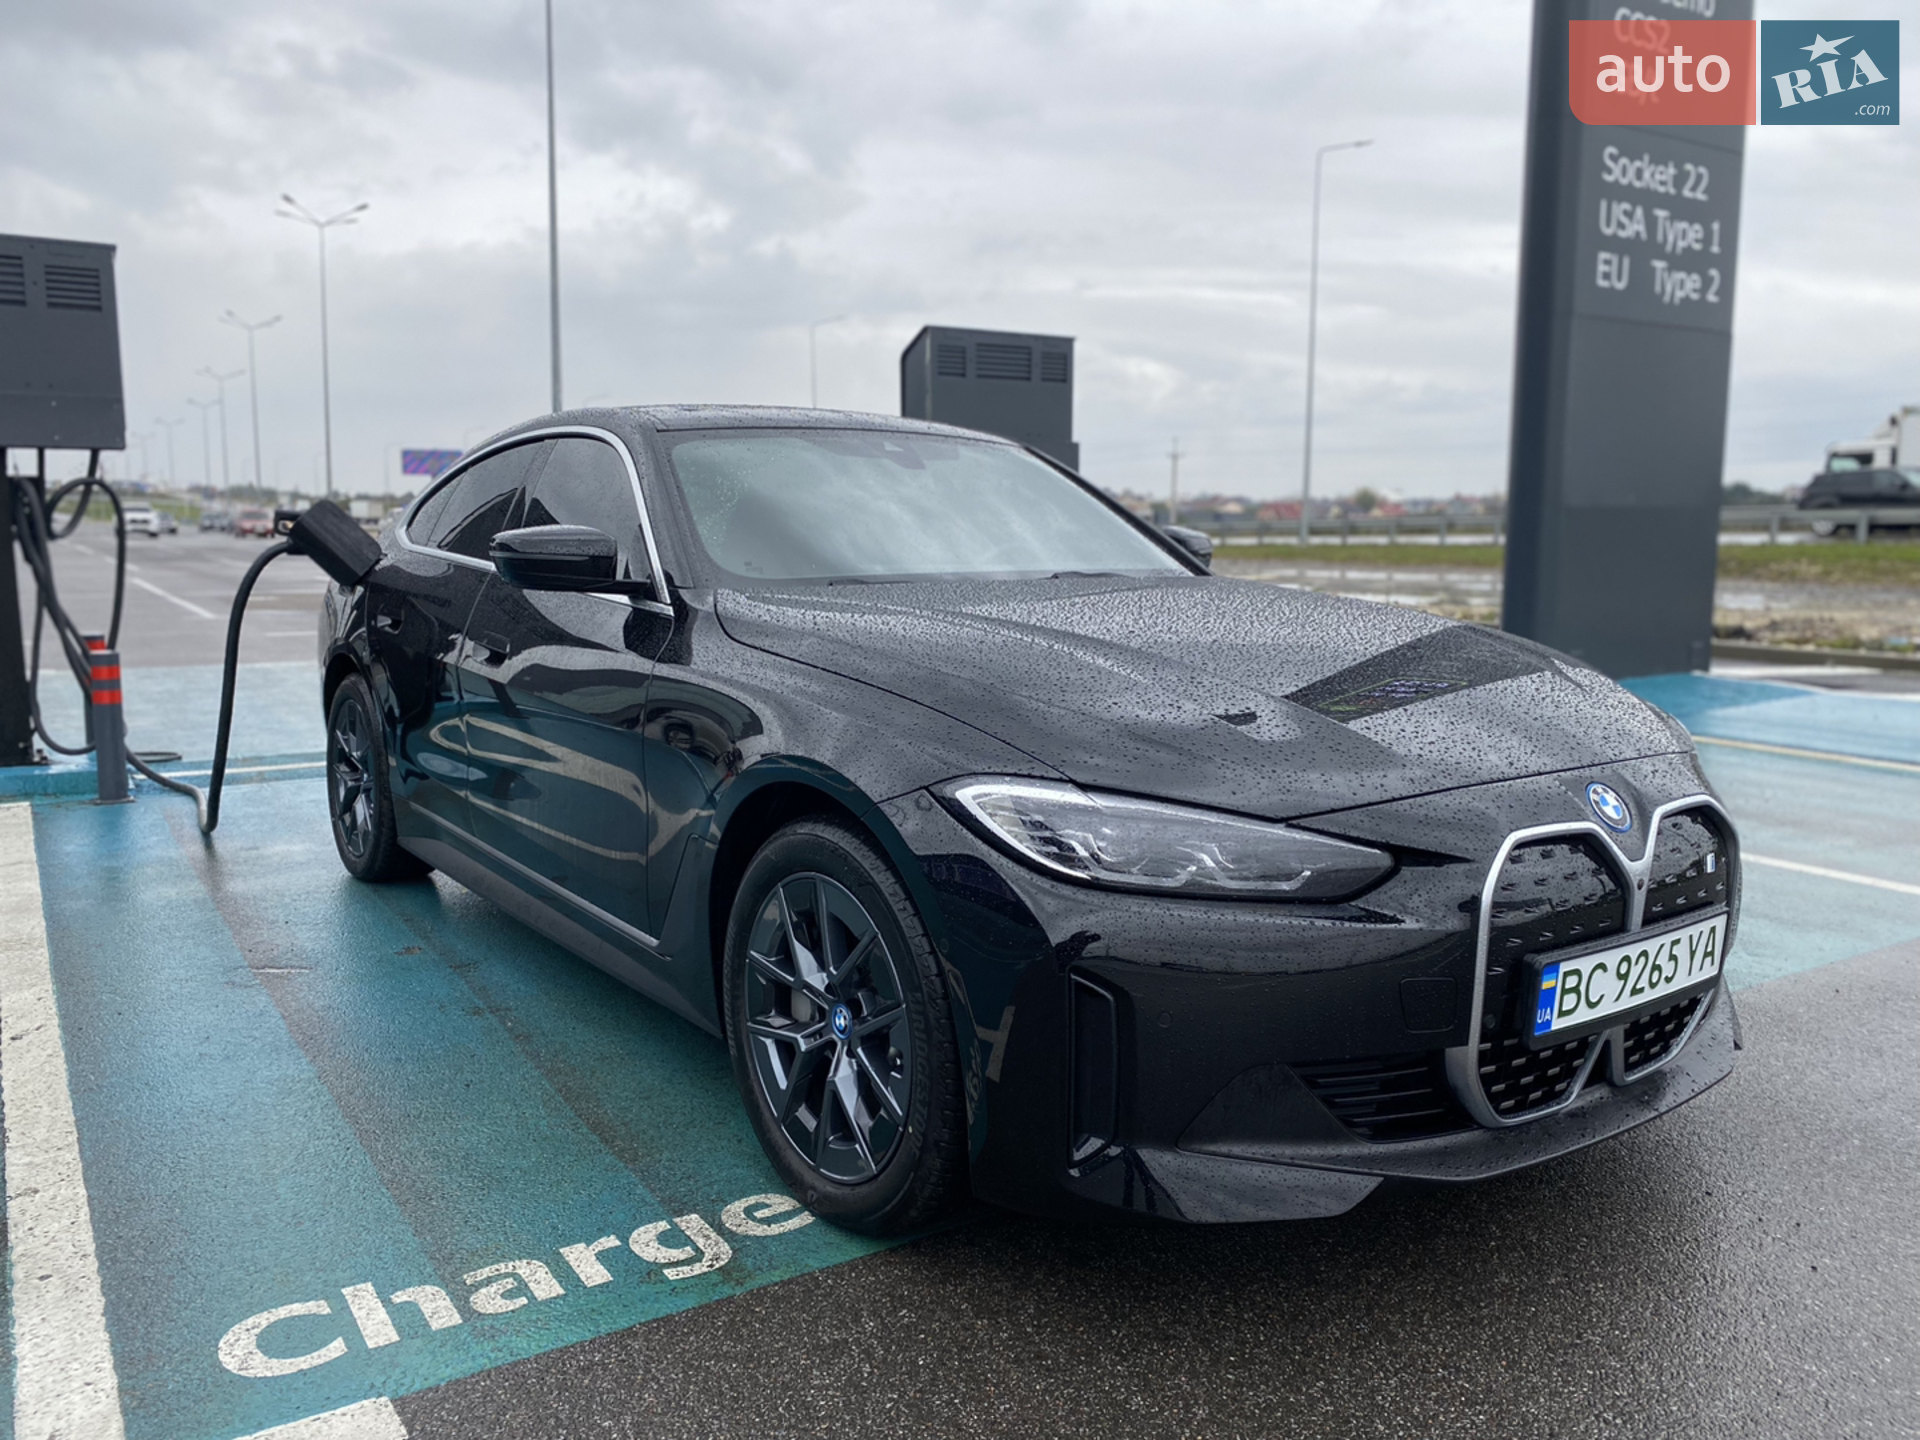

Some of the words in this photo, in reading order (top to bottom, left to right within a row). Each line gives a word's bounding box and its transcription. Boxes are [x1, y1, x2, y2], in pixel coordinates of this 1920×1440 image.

[1601, 145, 1677, 195] Socket
[1682, 162, 1710, 201] 22
[1599, 198, 1648, 241] USA
[1652, 207, 1704, 256] Type
[1710, 220, 1721, 254] 1
[1596, 250, 1630, 291] EU
[1650, 259, 1702, 306] Type
[1705, 267, 1721, 303] 2
[1557, 962, 1609, 1019] BC
[1613, 938, 1682, 1003] 9265
[1687, 925, 1717, 977] YA
[1537, 1008, 1551, 1023] UA
[217, 1192, 816, 1379] Charge
